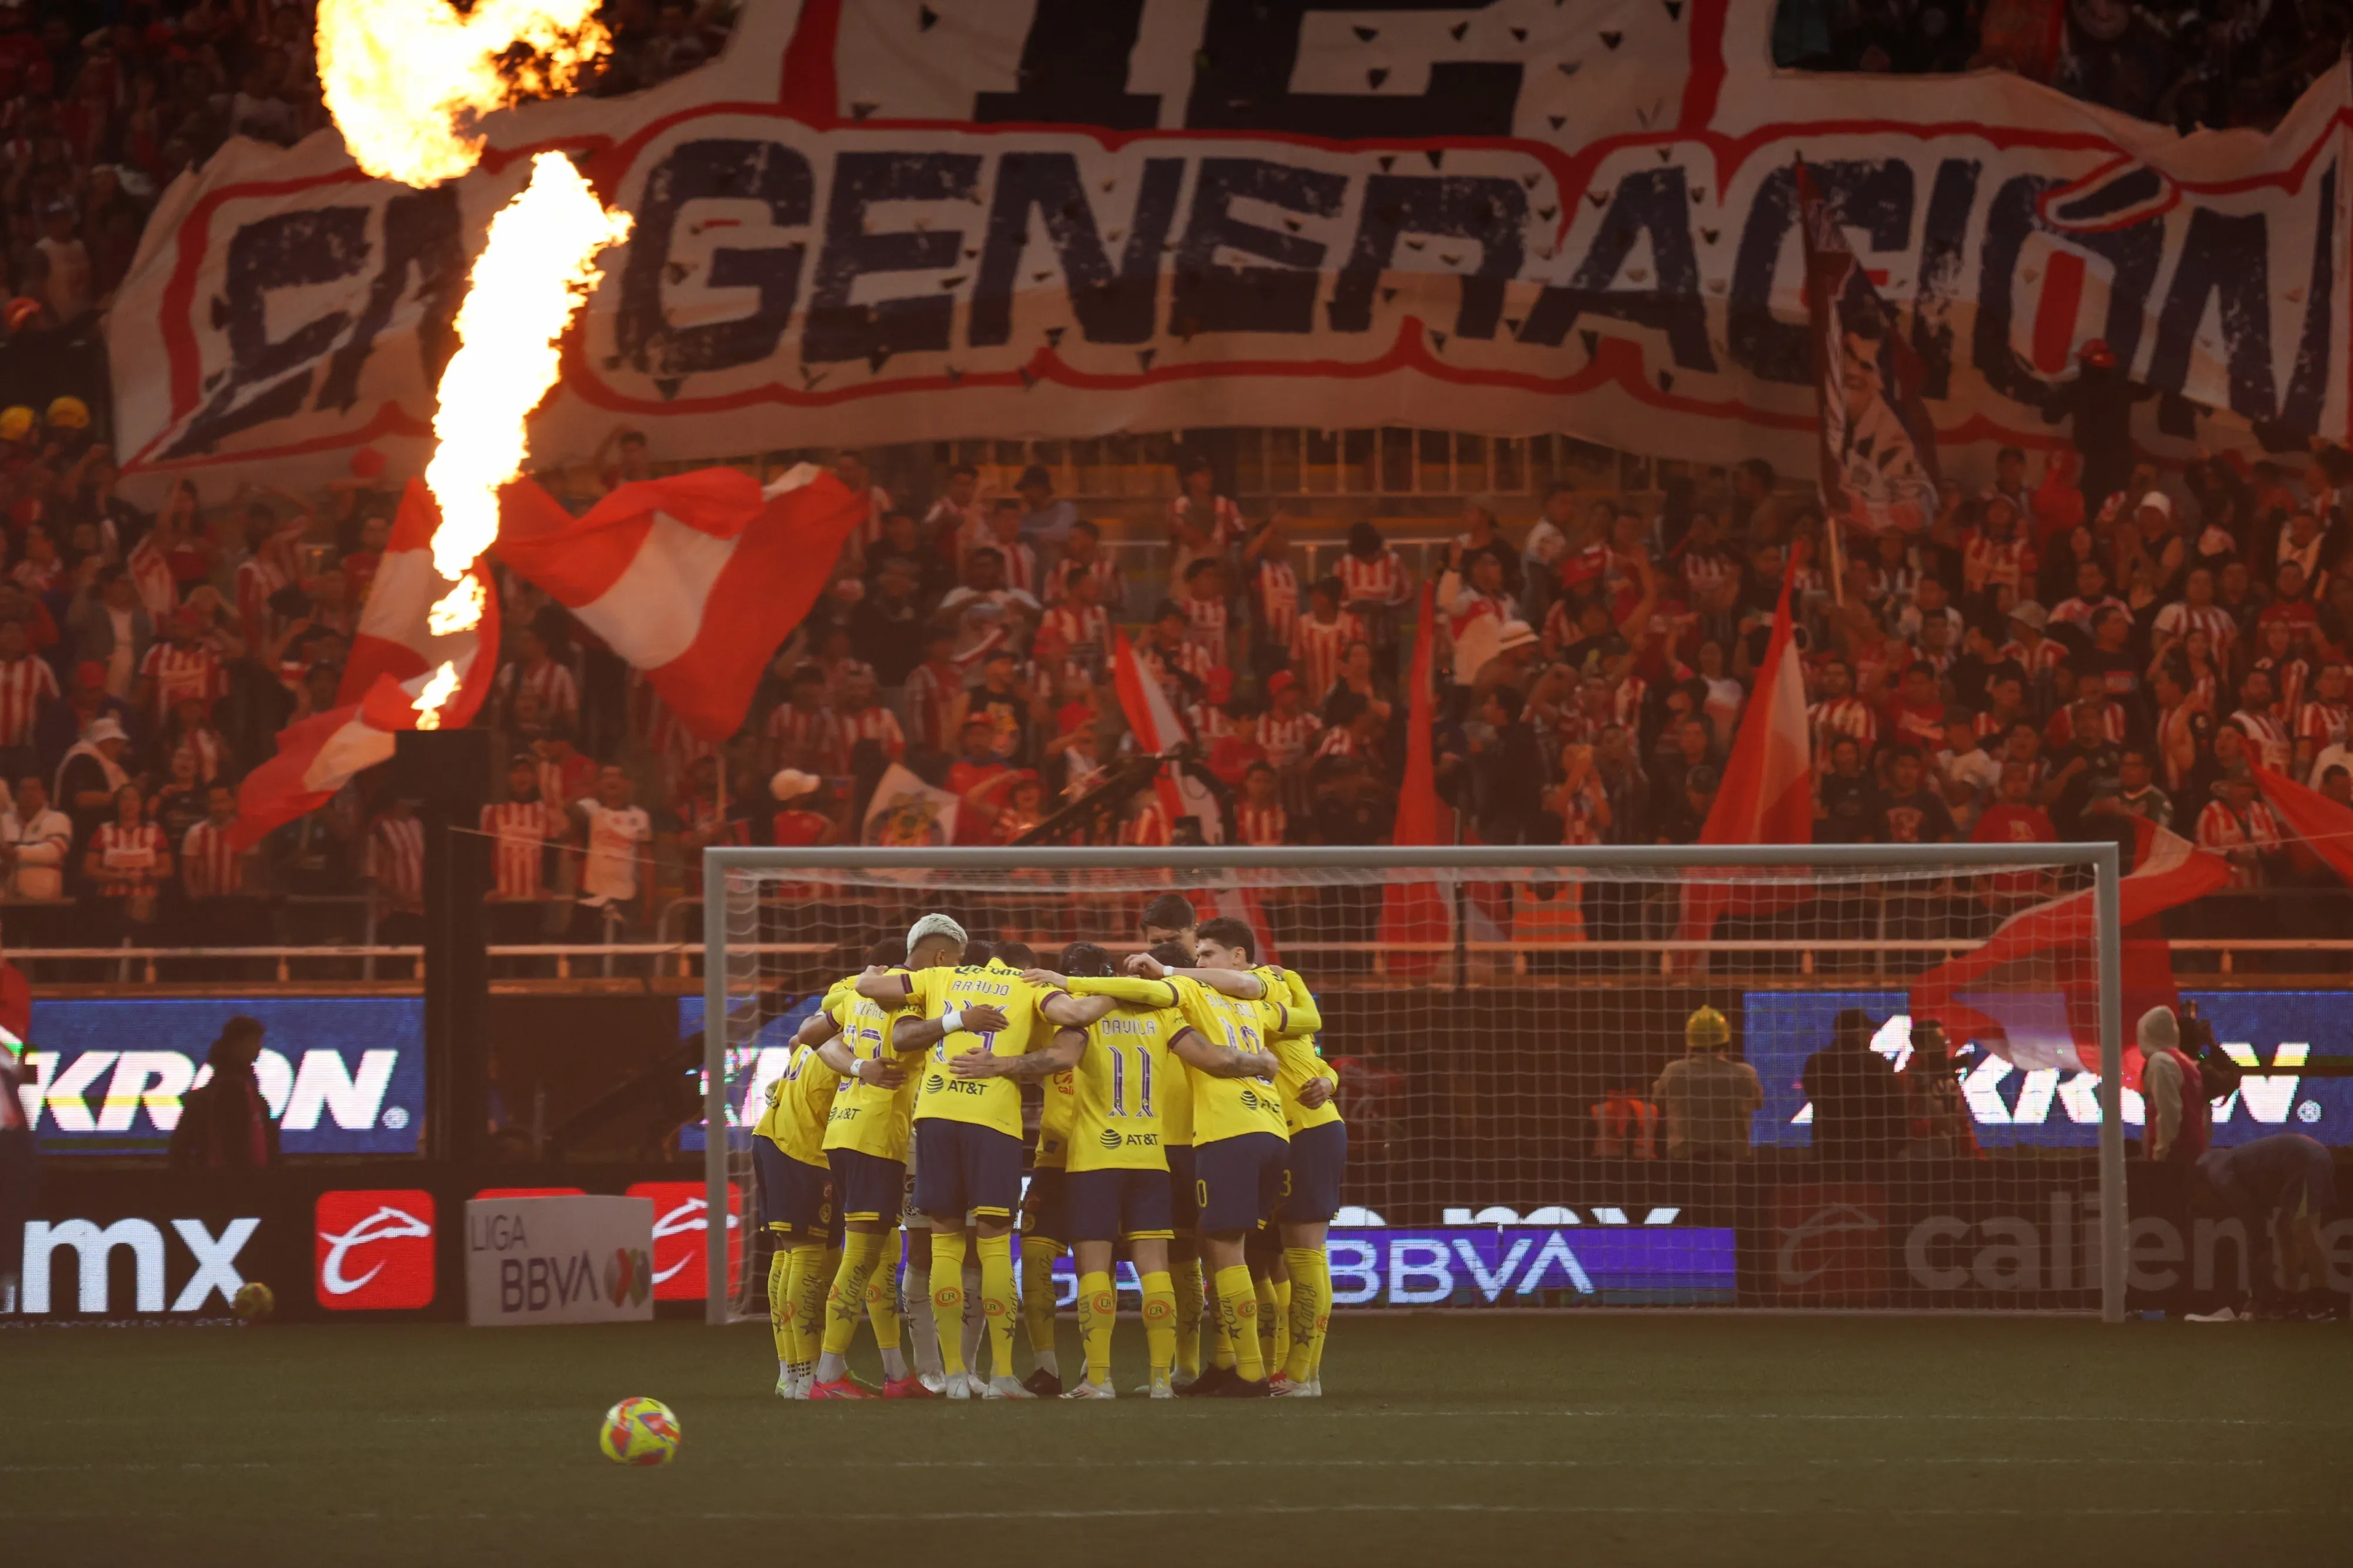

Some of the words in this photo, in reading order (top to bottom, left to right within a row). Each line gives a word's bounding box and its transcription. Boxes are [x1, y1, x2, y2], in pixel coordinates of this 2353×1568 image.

[616, 138, 2339, 452] GENERACIÓN
[951, 979, 1009, 997] ARAUJO
[947, 1080, 989, 1096] AT&T
[1106, 1045, 1154, 1118] 11
[1126, 1134, 1159, 1146] AT&T
[471, 1215, 528, 1251] LIGA
[501, 1249, 599, 1313] BBVA
[1327, 1229, 1596, 1303] BBVA
